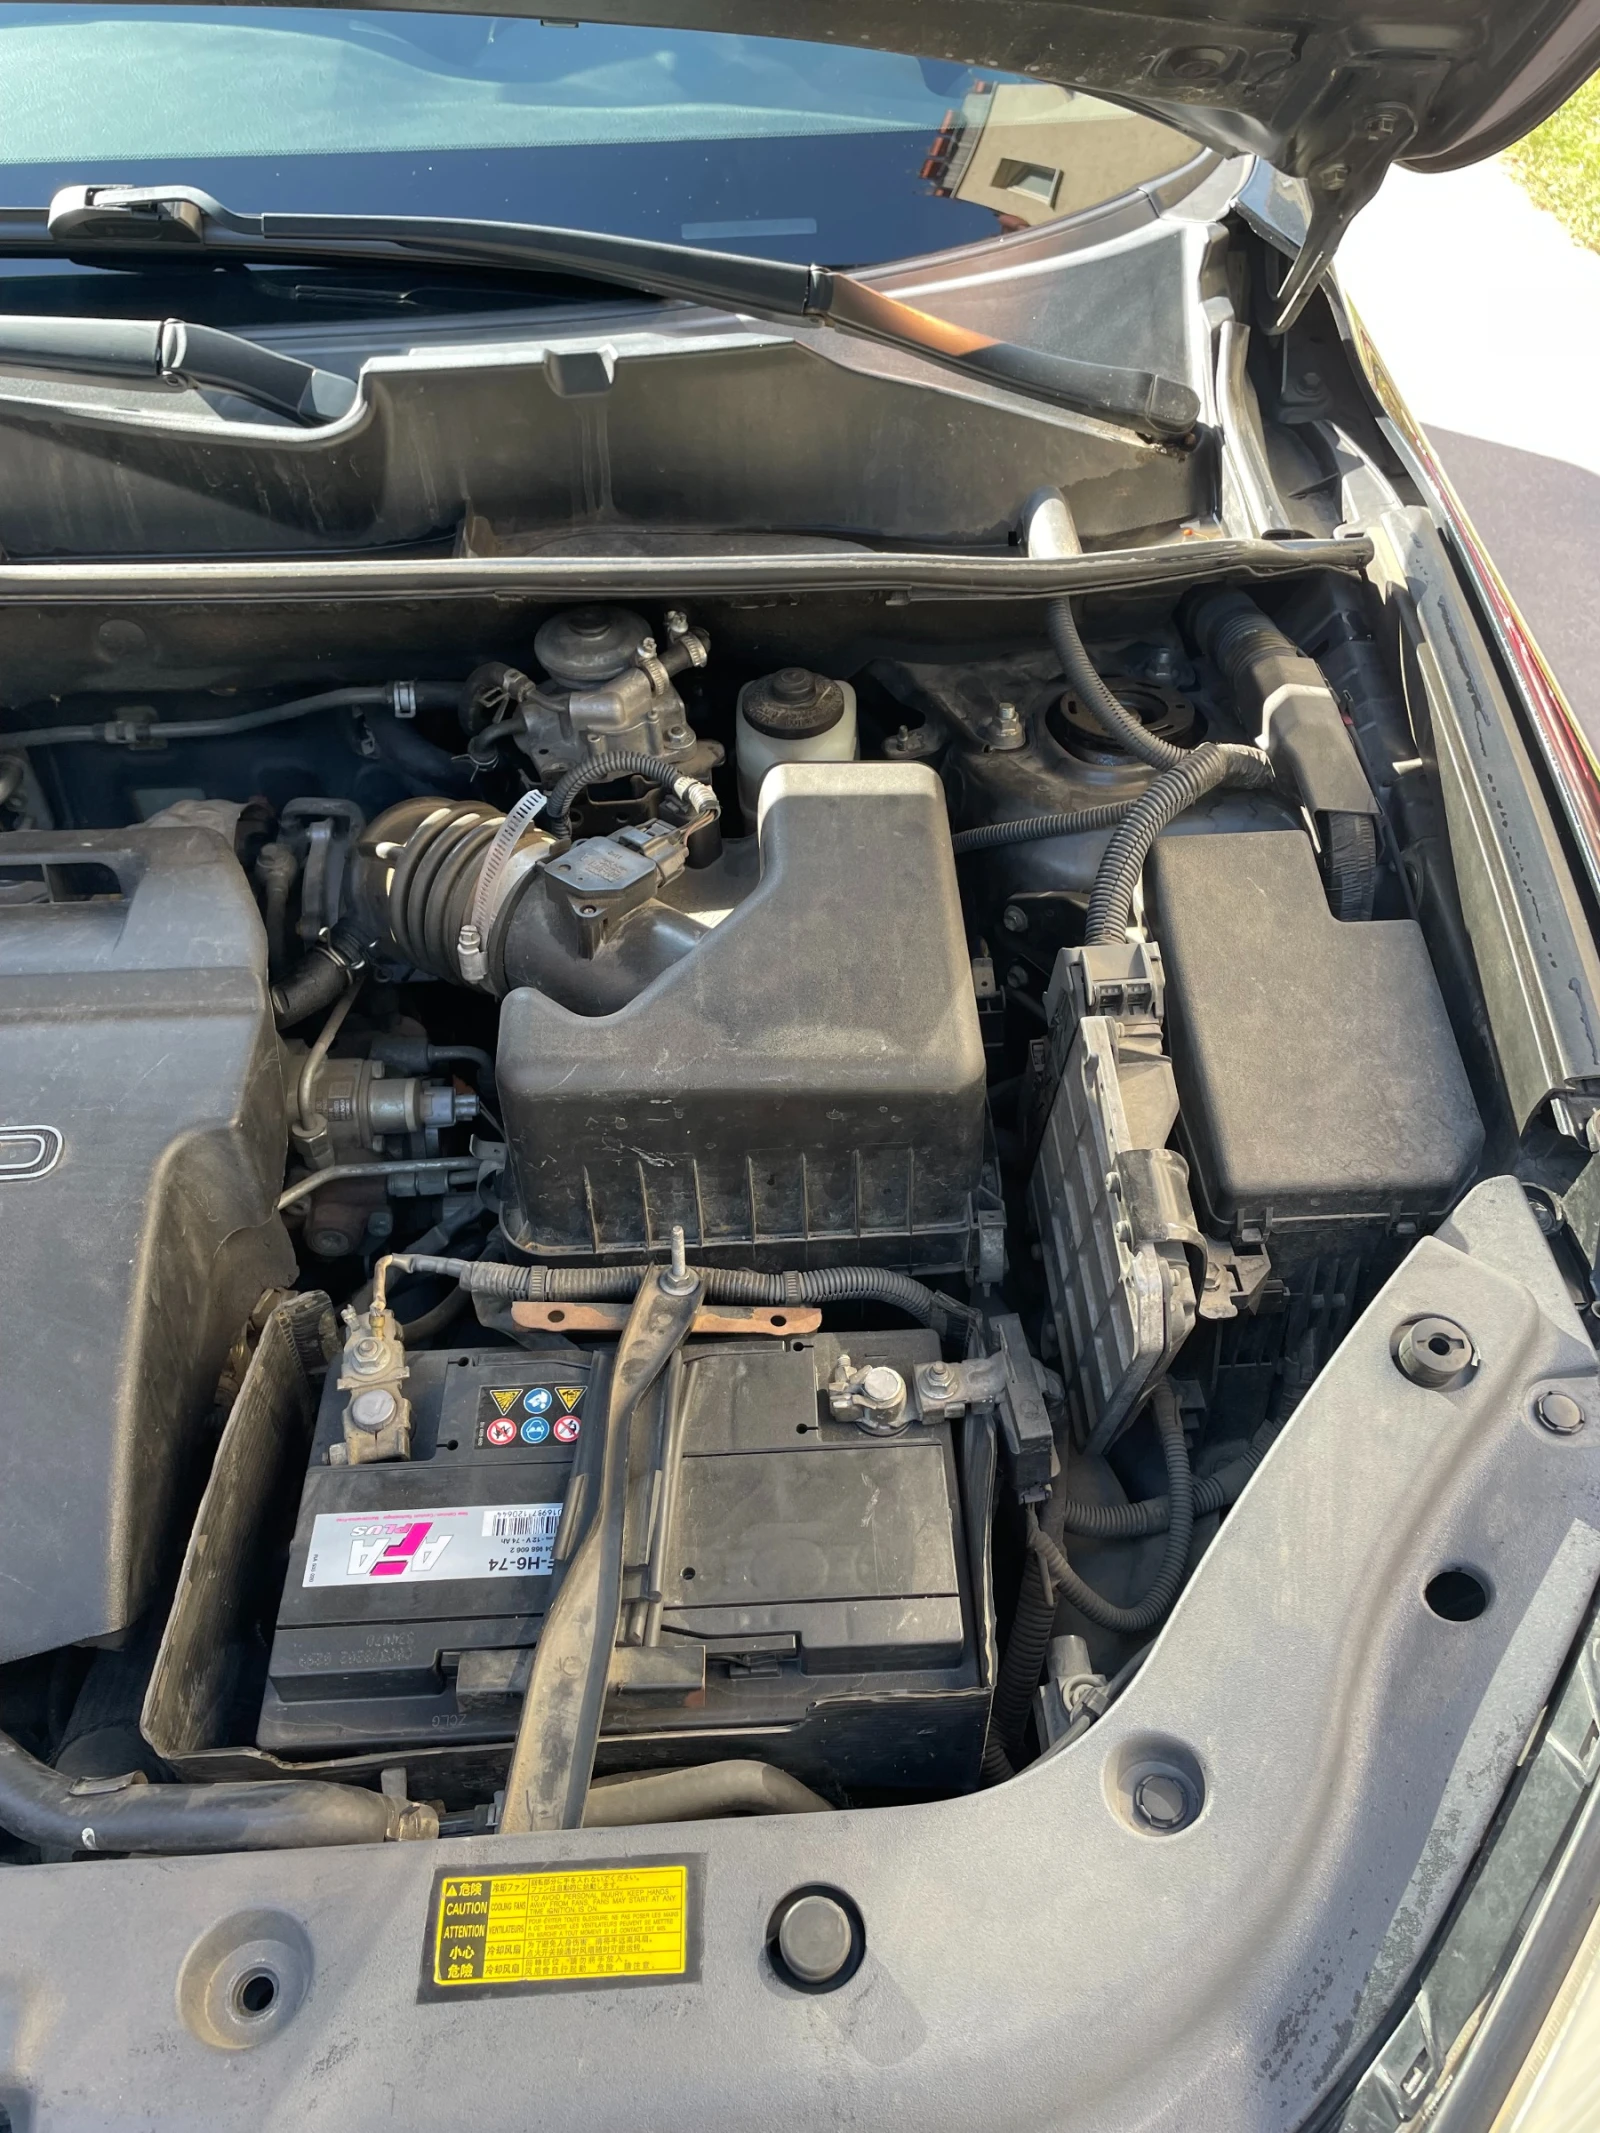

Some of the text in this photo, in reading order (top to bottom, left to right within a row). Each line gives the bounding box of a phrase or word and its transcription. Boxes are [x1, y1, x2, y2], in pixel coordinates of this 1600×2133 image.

[350, 1523, 413, 1536] PLUS
[458, 1882, 482, 1896] 危険
[563, 1891, 597, 1899] PERSONAL
[445, 1901, 487, 1915] CAUTION
[490, 1901, 525, 1911] COOLING FANS
[443, 1924, 485, 1939] ATTENTION
[488, 1924, 524, 1934] VENTILATEURS
[448, 1944, 475, 1960] 小心
[487, 1944, 521, 1955] 冷却风扇
[447, 1963, 473, 1978] 危險
